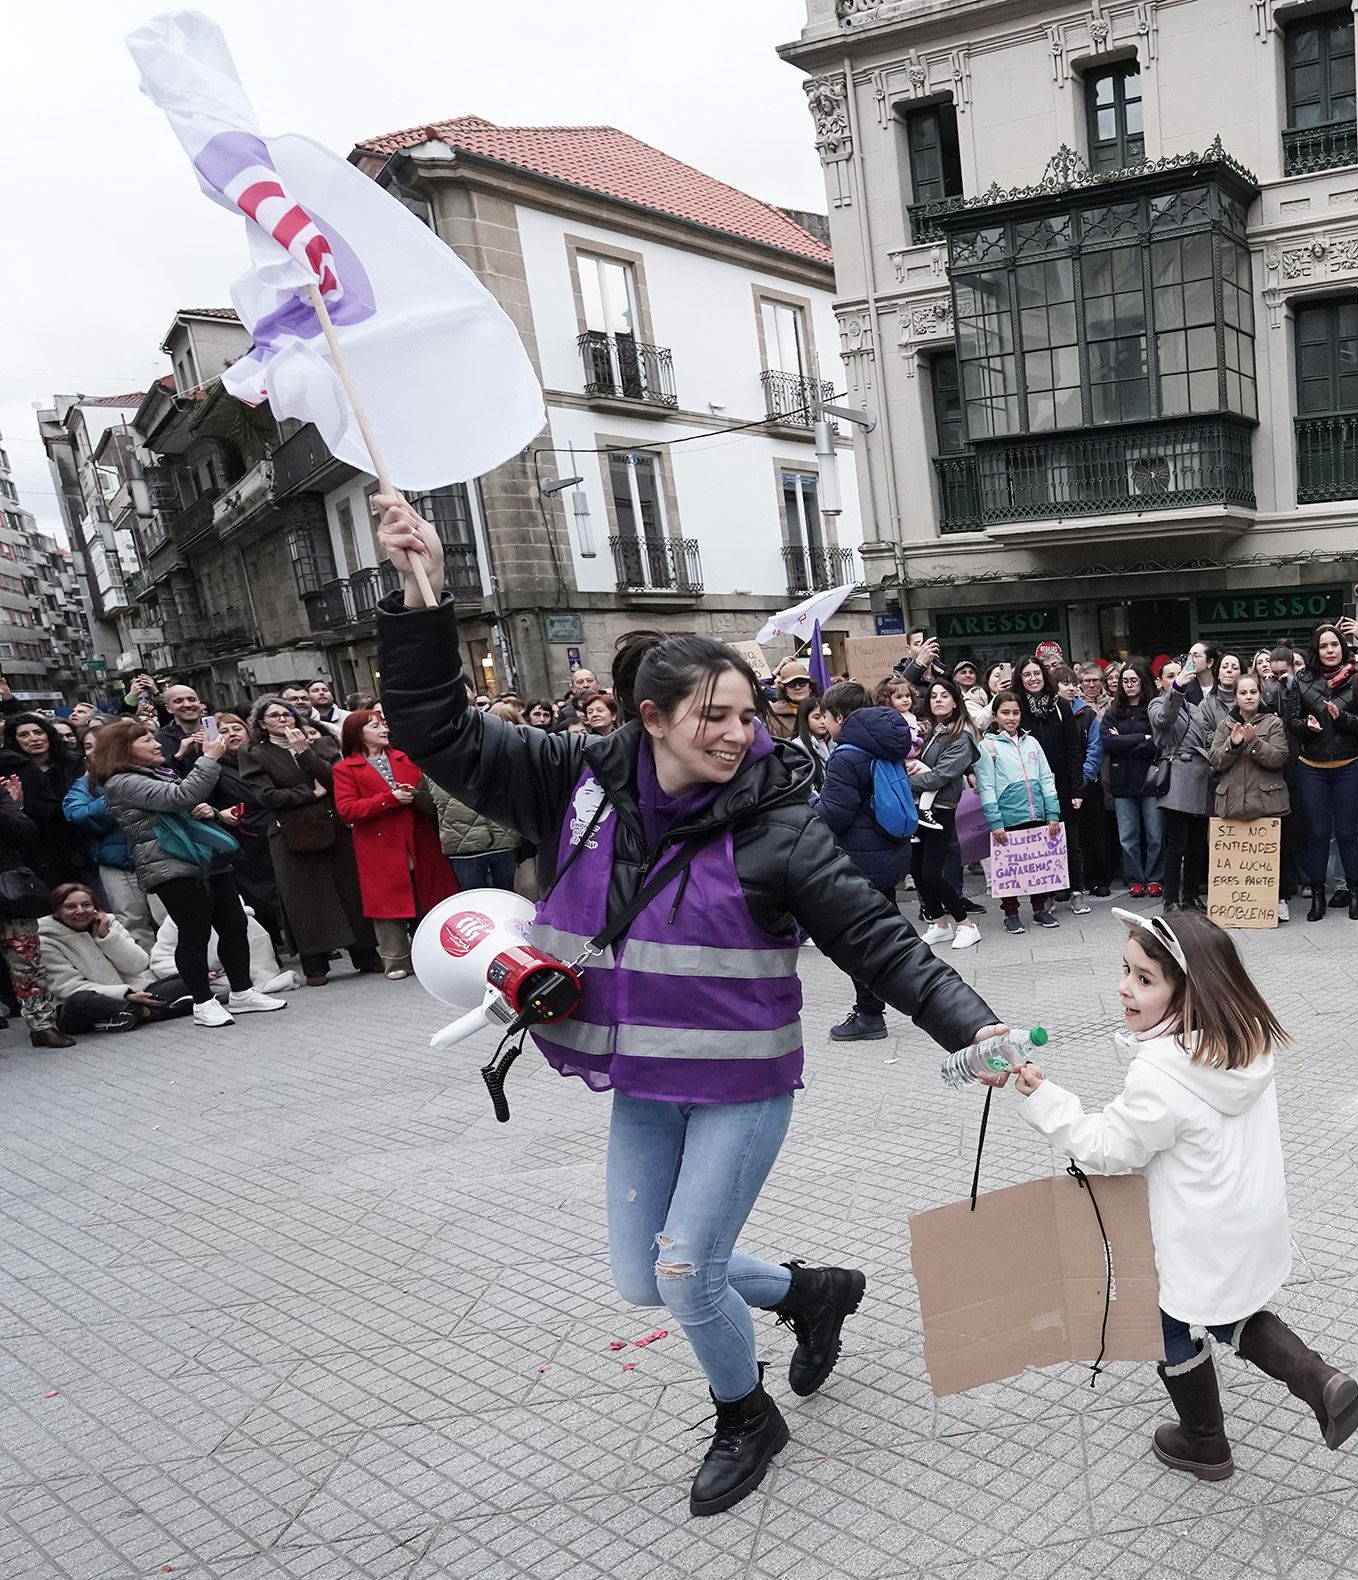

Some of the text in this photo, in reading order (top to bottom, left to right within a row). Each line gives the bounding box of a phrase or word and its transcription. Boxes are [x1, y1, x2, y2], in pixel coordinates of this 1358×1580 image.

[1212, 596, 1326, 620] ARESSO
[949, 612, 1044, 635] ARESSO
[1218, 826, 1268, 837] SI NO
[1214, 840, 1278, 854] ENTIENDES
[1217, 858, 1272, 871] LA LUCHA
[998, 880, 1021, 890] ESTA
[1028, 875, 1062, 887] LOITA
[1212, 876, 1275, 887] ERES PARTE
[1232, 892, 1257, 902] DEL
[1210, 904, 1275, 920] PROBLEMA
